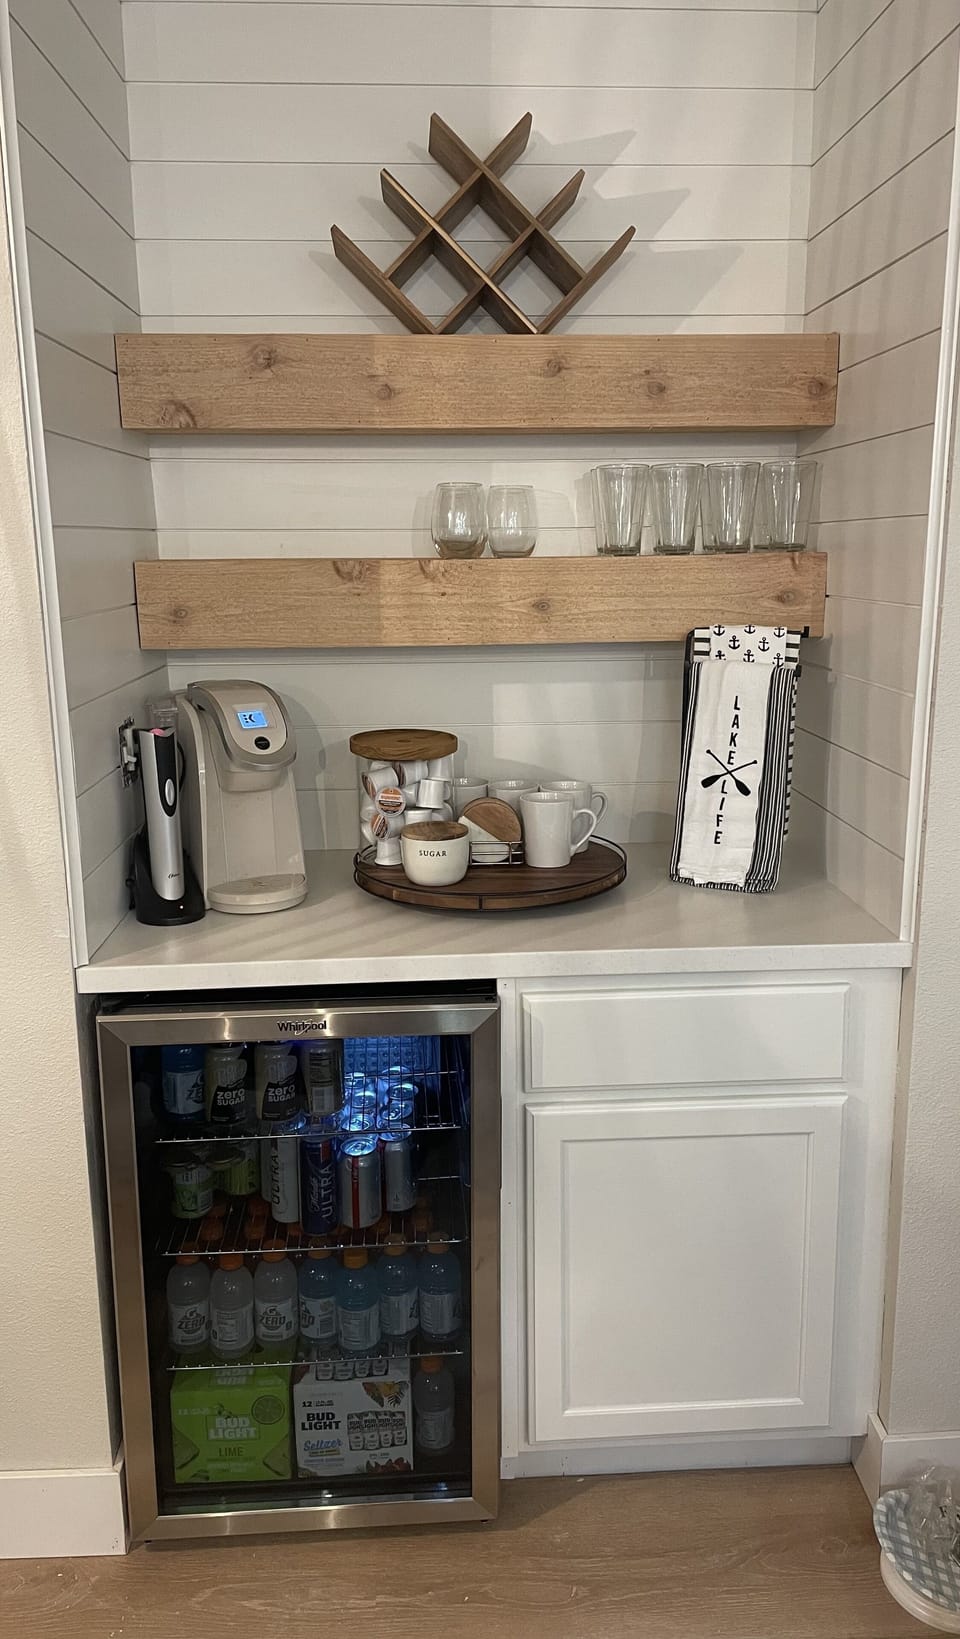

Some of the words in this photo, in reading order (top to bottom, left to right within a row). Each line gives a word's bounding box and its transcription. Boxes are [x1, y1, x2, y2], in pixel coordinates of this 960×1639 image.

[727, 695, 741, 766] LAKE
[713, 779, 728, 845] LIFE
[418, 850, 447, 858] SUGAR
[276, 1020, 327, 1033] Whirlpool
[216, 1088, 246, 1100] zero
[267, 1084, 296, 1097] zero
[217, 1096, 246, 1106] SUGAR
[268, 1092, 296, 1103] SUGAR
[320, 1162, 335, 1218] ULTRA
[302, 1400, 313, 1408] 12
[215, 1416, 251, 1427] BUD
[306, 1412, 336, 1421] BUD
[301, 1421, 342, 1431] LIGHT
[207, 1427, 257, 1440] LIGHT
[303, 1438, 343, 1451] Seltzer
[218, 1447, 244, 1457] LIME
